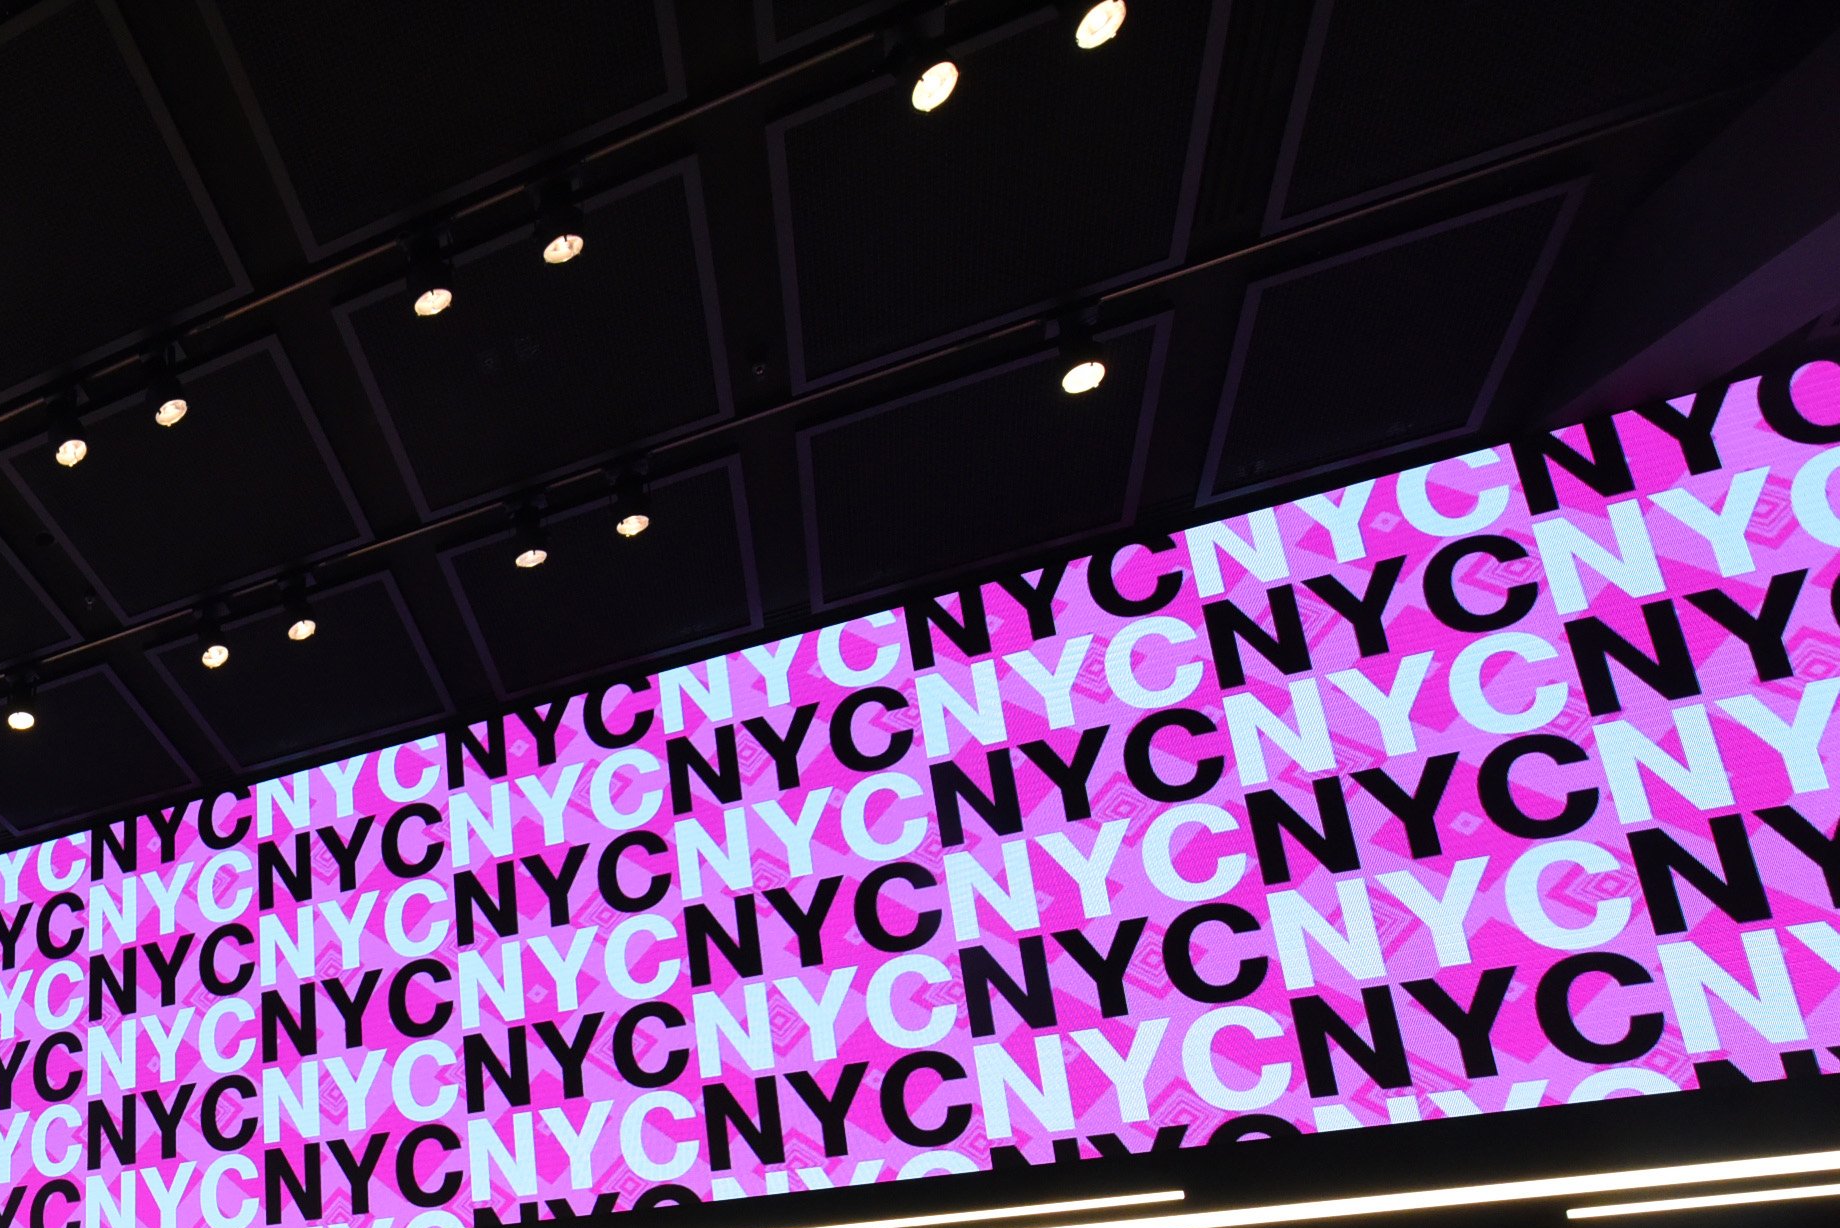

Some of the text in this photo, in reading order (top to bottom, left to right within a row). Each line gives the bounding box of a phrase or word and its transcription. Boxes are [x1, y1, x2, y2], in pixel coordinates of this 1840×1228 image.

[89, 850, 253, 951] NYC
[258, 803, 444, 909] NYC
[449, 749, 663, 867] NYC
[667, 687, 913, 814] NYC
[915, 617, 1203, 758] NYC
[1203, 535, 1537, 689] NYC
[89, 924, 254, 1021] NYC
[260, 879, 449, 986] NYC
[454, 831, 671, 945] NYC
[675, 772, 928, 900] NYC
[930, 709, 1224, 847] NYC
[1223, 632, 1568, 786] NYC
[1565, 570, 1840, 716] NY
[90, 785, 252, 881] NYC
[256, 735, 441, 839] NYC
[444, 676, 655, 791] NYC
[658, 610, 901, 734] NYC
[903, 534, 1184, 671] NYC
[1184, 449, 1510, 598] NYC
[87, 998, 256, 1096] NYC
[262, 959, 453, 1062] NYC
[458, 914, 680, 1029] NYC
[685, 862, 941, 986] NYC
[944, 803, 1246, 941] NYC
[1245, 734, 1598, 885] NYC
[88, 1075, 257, 1169] NYC
[263, 1040, 458, 1143] NYC
[464, 1002, 689, 1113] NYC
[693, 954, 957, 1077] NYC
[960, 903, 1268, 1037] NYC
[1267, 840, 1631, 989] NYC
[265, 1124, 463, 1224] NYC
[468, 1091, 699, 1201] NYC
[704, 1051, 972, 1170] NYC
[974, 1006, 1291, 1139] NYC
[1291, 952, 1663, 1097] NYC
